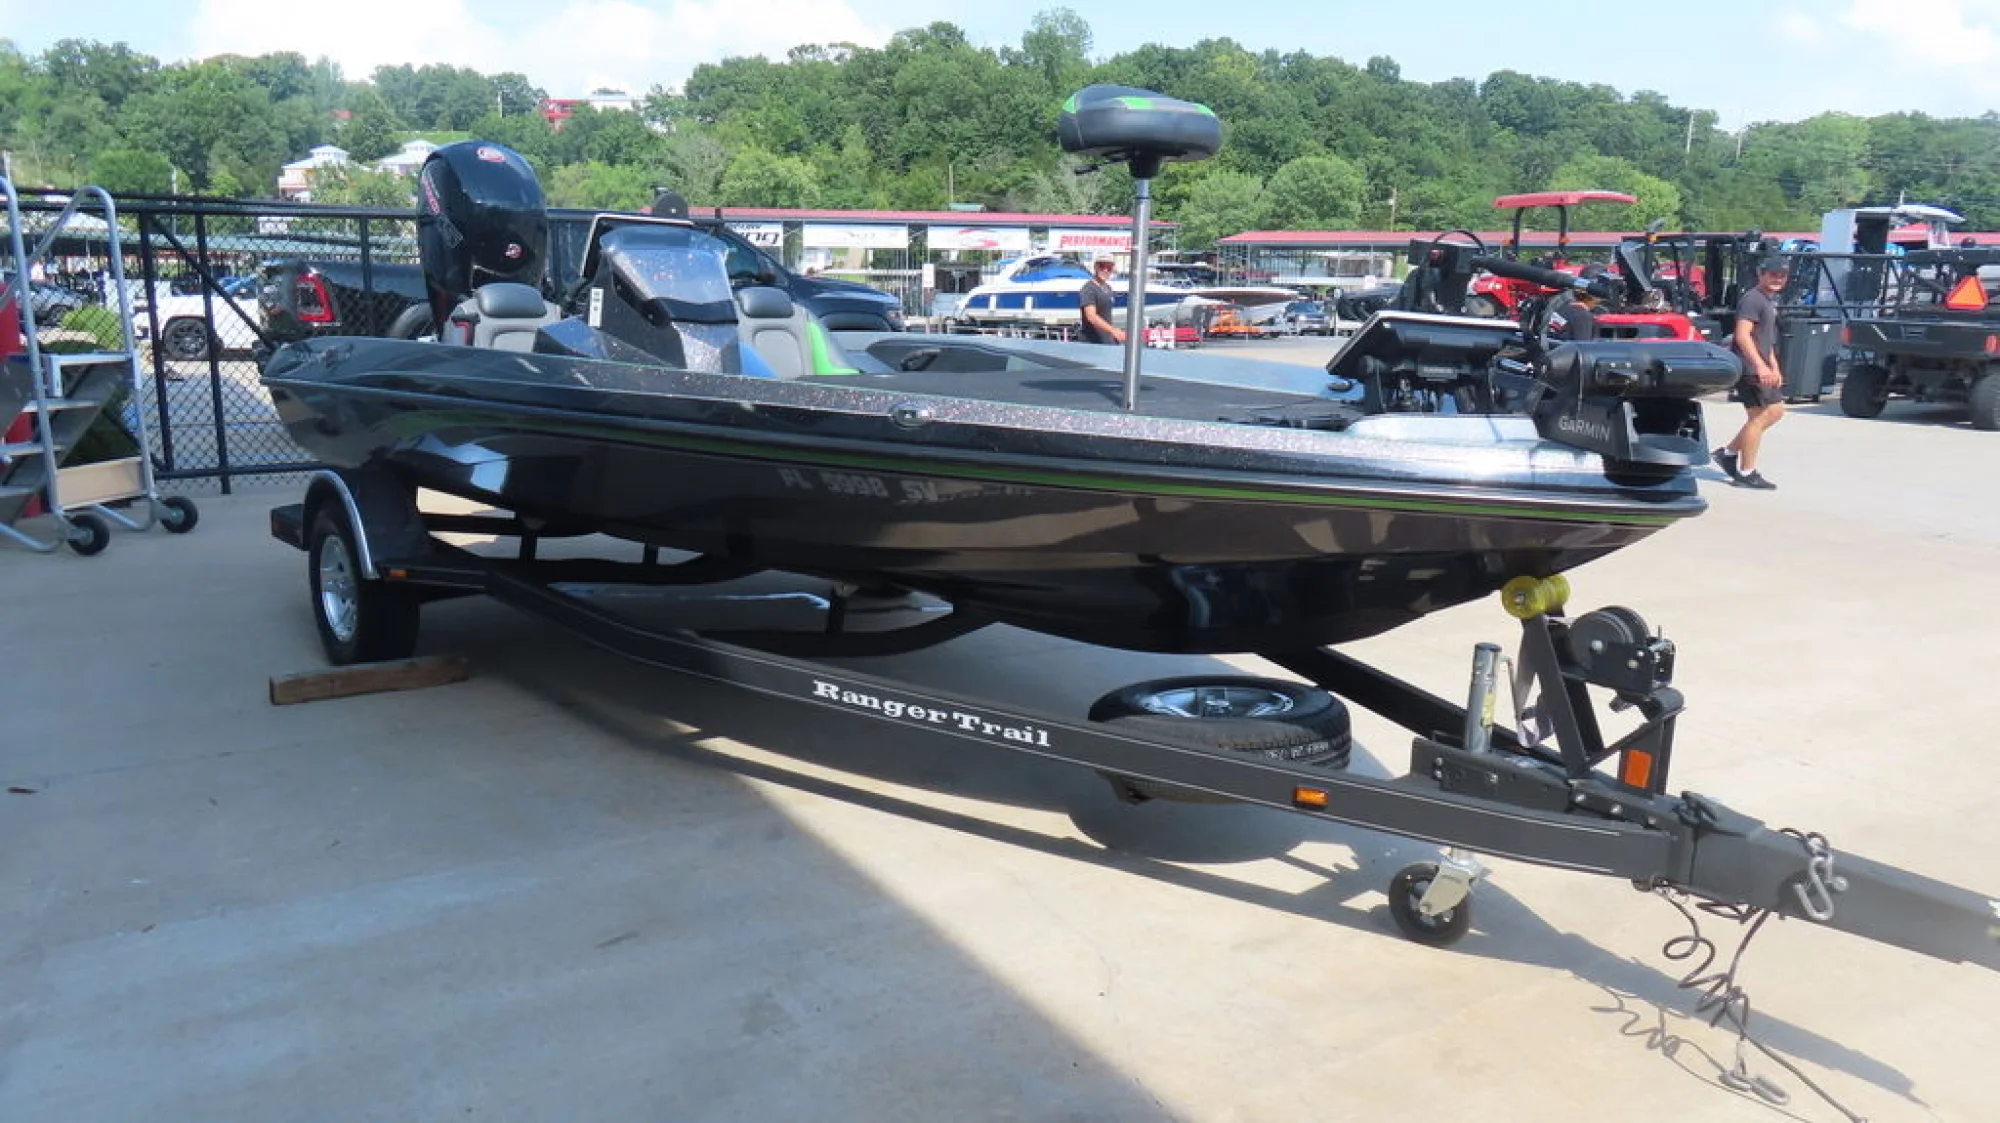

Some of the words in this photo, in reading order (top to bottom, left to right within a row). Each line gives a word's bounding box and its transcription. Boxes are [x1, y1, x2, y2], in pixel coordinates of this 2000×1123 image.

[1559, 415, 1610, 441] GARMIN
[812, 680, 948, 723] Ranger
[952, 711, 1051, 747] Trail
